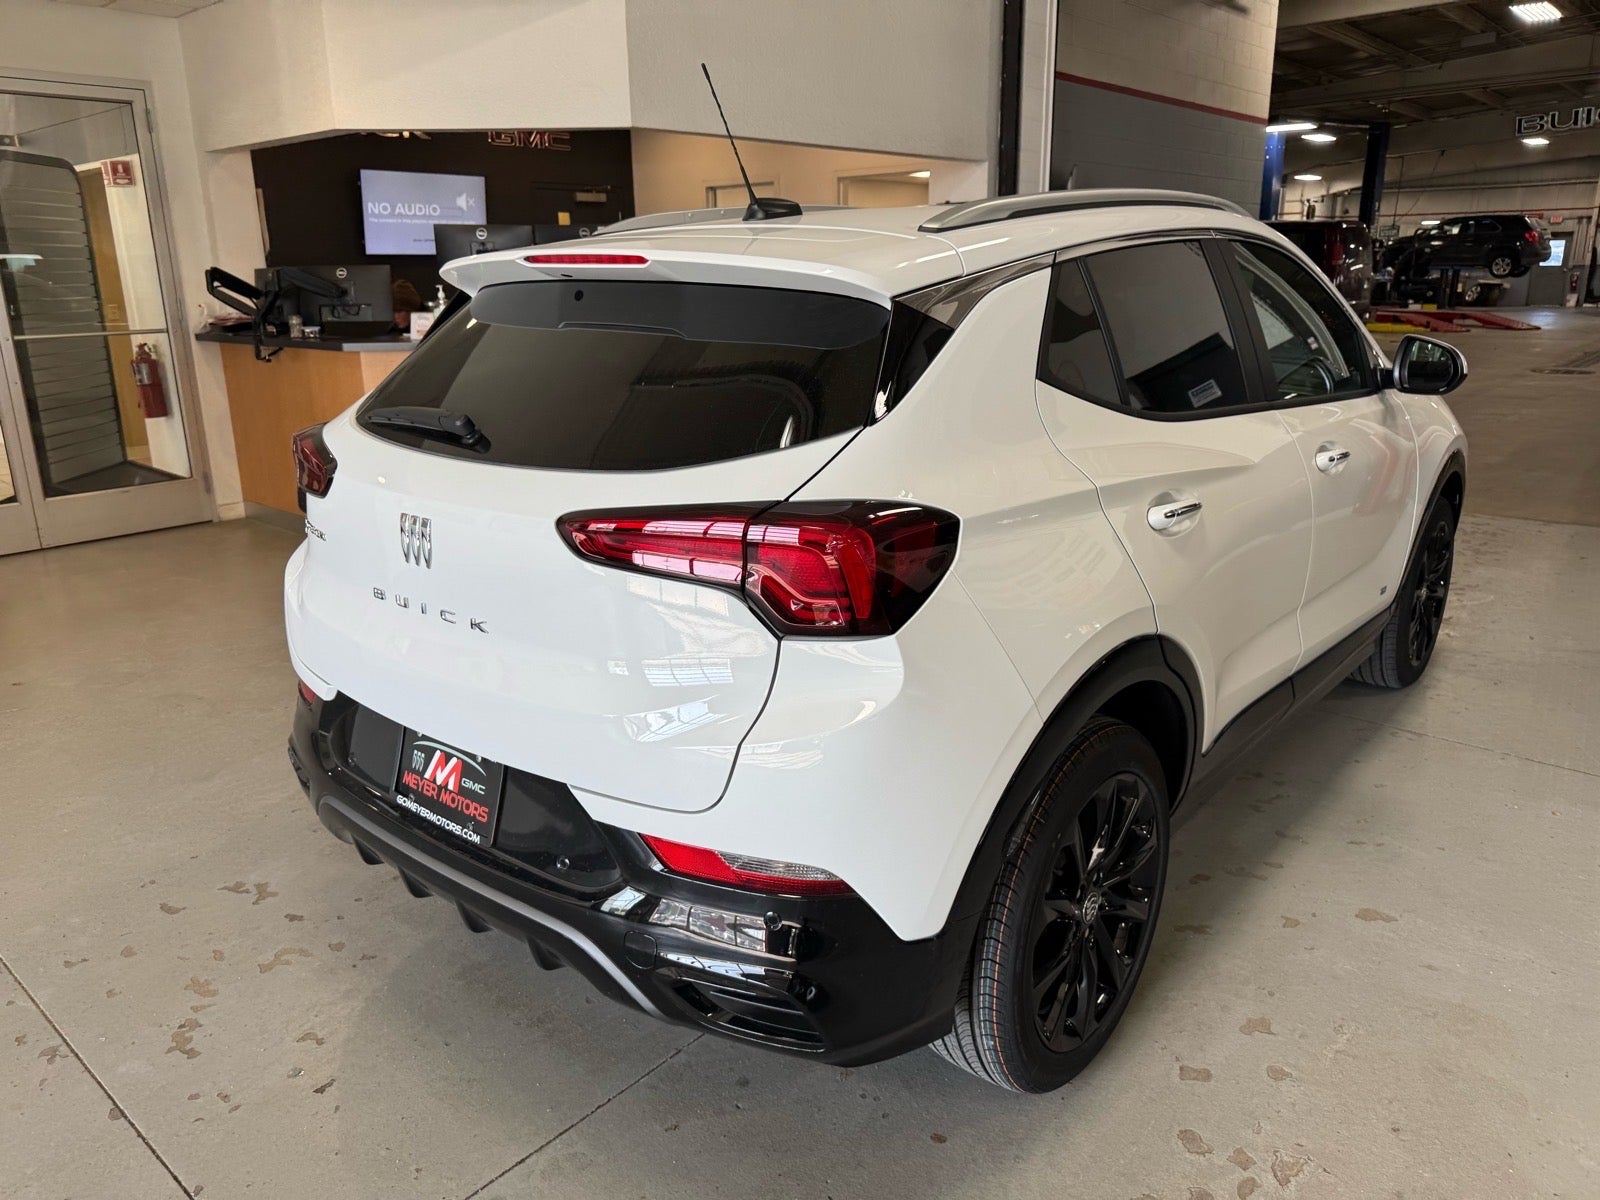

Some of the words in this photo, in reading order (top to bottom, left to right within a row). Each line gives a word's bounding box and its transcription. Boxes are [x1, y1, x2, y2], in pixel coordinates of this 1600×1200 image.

[1515, 106, 1600, 136] BUI
[367, 202, 391, 215] NO
[394, 203, 440, 216] AUDIO
[373, 587, 489, 634] BUICK
[402, 769, 438, 800] MEYER
[440, 788, 489, 823] MOTORS
[461, 777, 486, 795] GMC
[396, 794, 481, 845] GOMEYERMOTORS.COM
